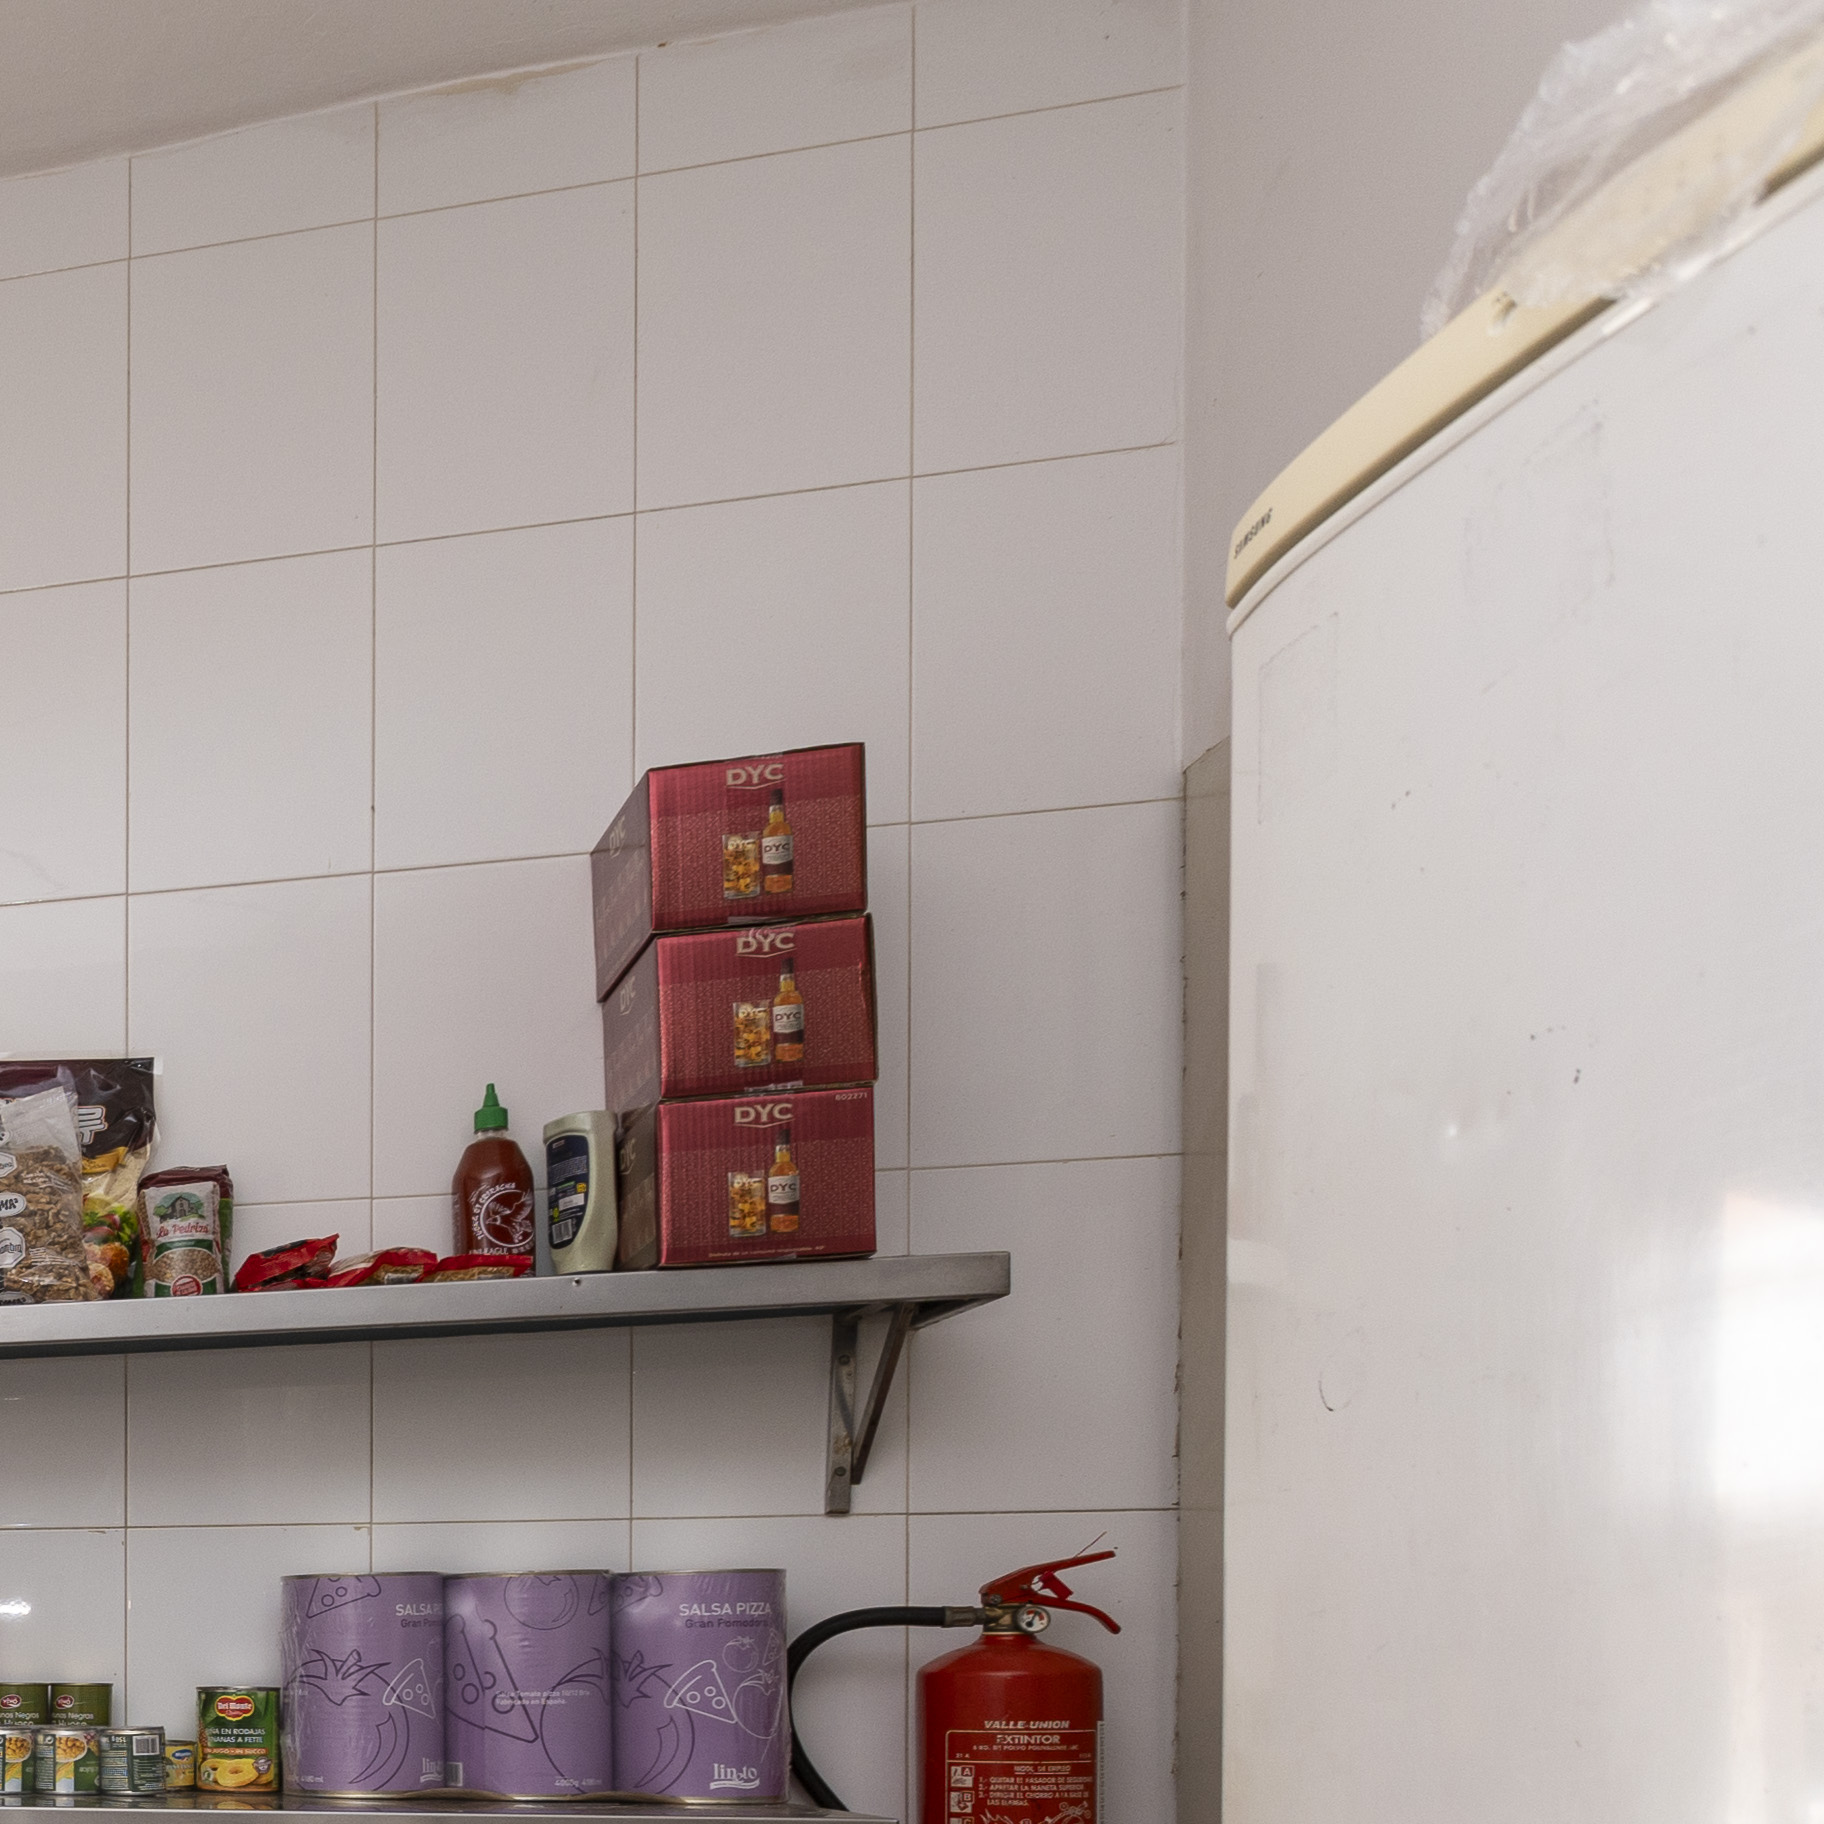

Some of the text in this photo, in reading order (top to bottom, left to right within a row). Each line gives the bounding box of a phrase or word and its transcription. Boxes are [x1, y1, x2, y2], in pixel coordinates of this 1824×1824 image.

[1233, 508, 1273, 560] SAMSUNG
[725, 764, 784, 786] DYC
[763, 842, 791, 852] DYC
[736, 932, 795, 954] DYC
[774, 1012, 801, 1021] DYC
[733, 1103, 793, 1124] DYC
[770, 1183, 797, 1193] DYC
[395, 1603, 433, 1617] SALSA
[679, 1602, 772, 1617] SALSA PIZZA
[685, 1618, 713, 1628] Gran
[217, 1699, 253, 1712] Del Monte
[221, 1727, 266, 1736] EN RODAJAS
[244, 1736, 264, 1744] FETTE
[995, 1734, 1061, 1744] EXTINTOR
